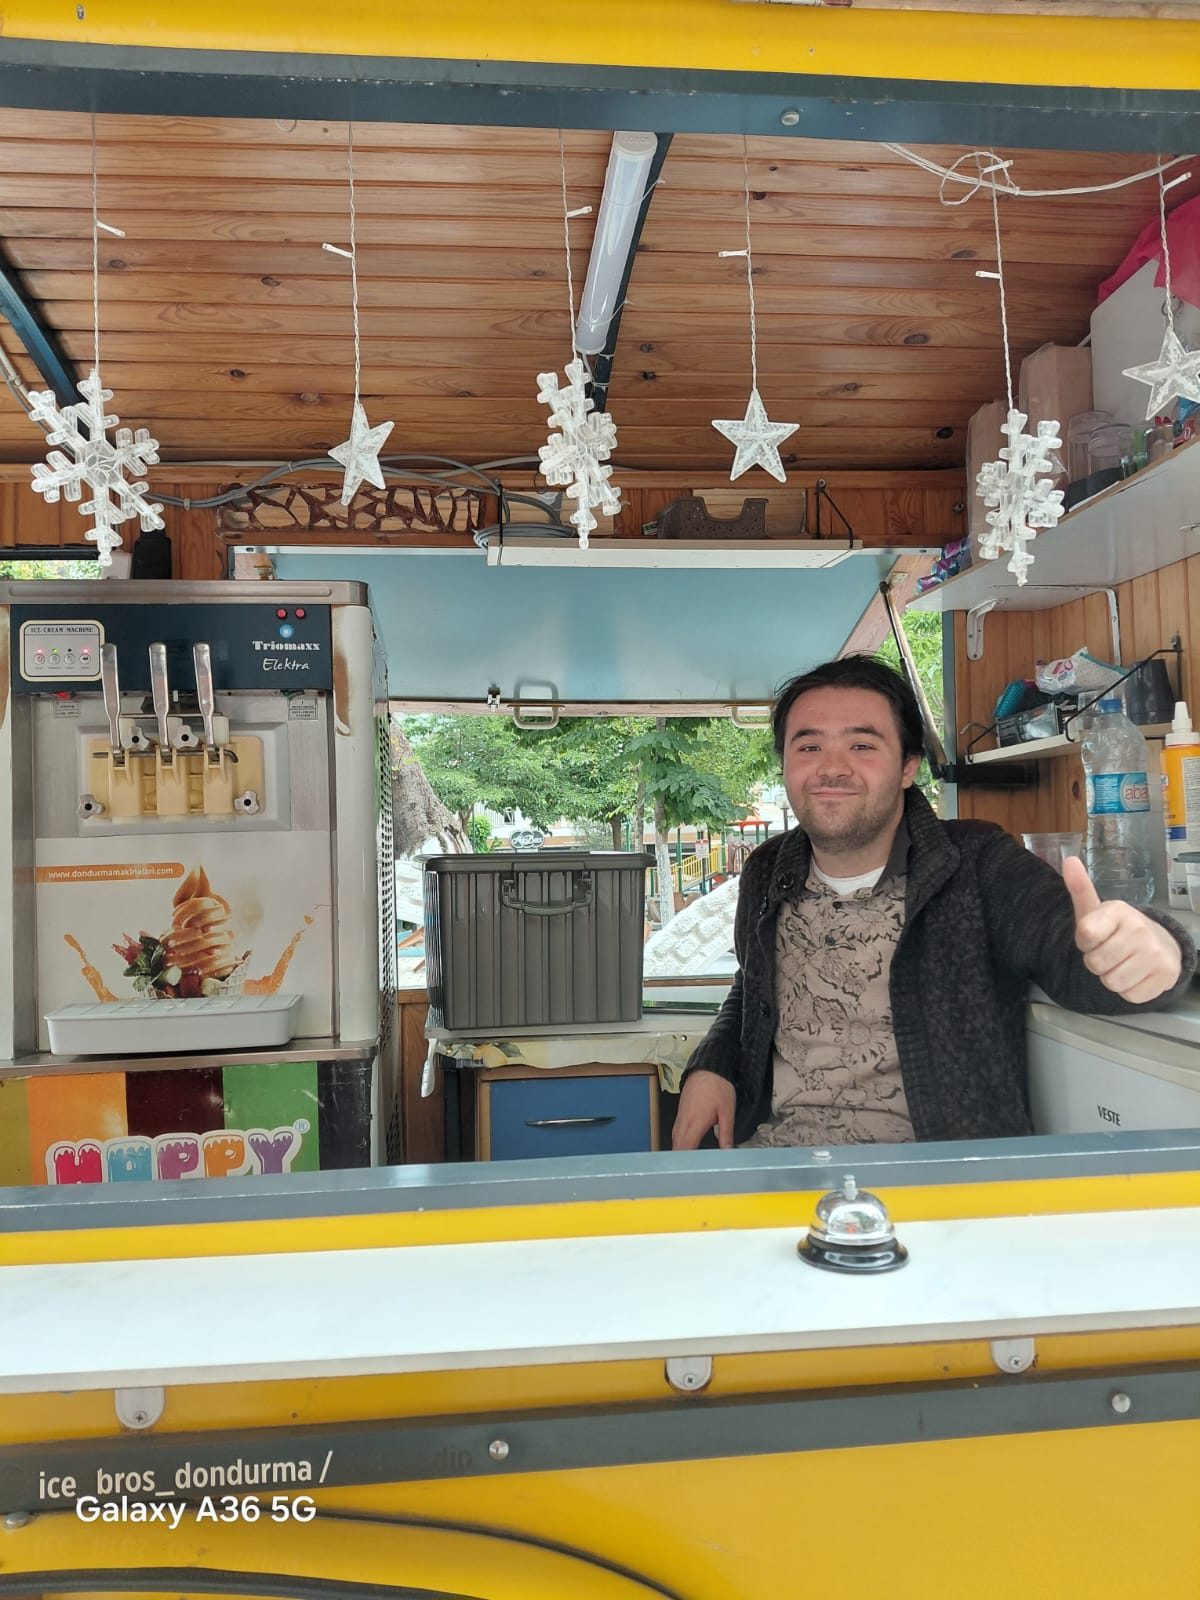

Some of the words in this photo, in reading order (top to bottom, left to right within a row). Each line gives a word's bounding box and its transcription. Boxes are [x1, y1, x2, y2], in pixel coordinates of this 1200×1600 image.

[252, 640, 321, 651] Triomaxx
[262, 657, 310, 671] Elektra
[38, 1458, 312, 1500] icebros_dondurma
